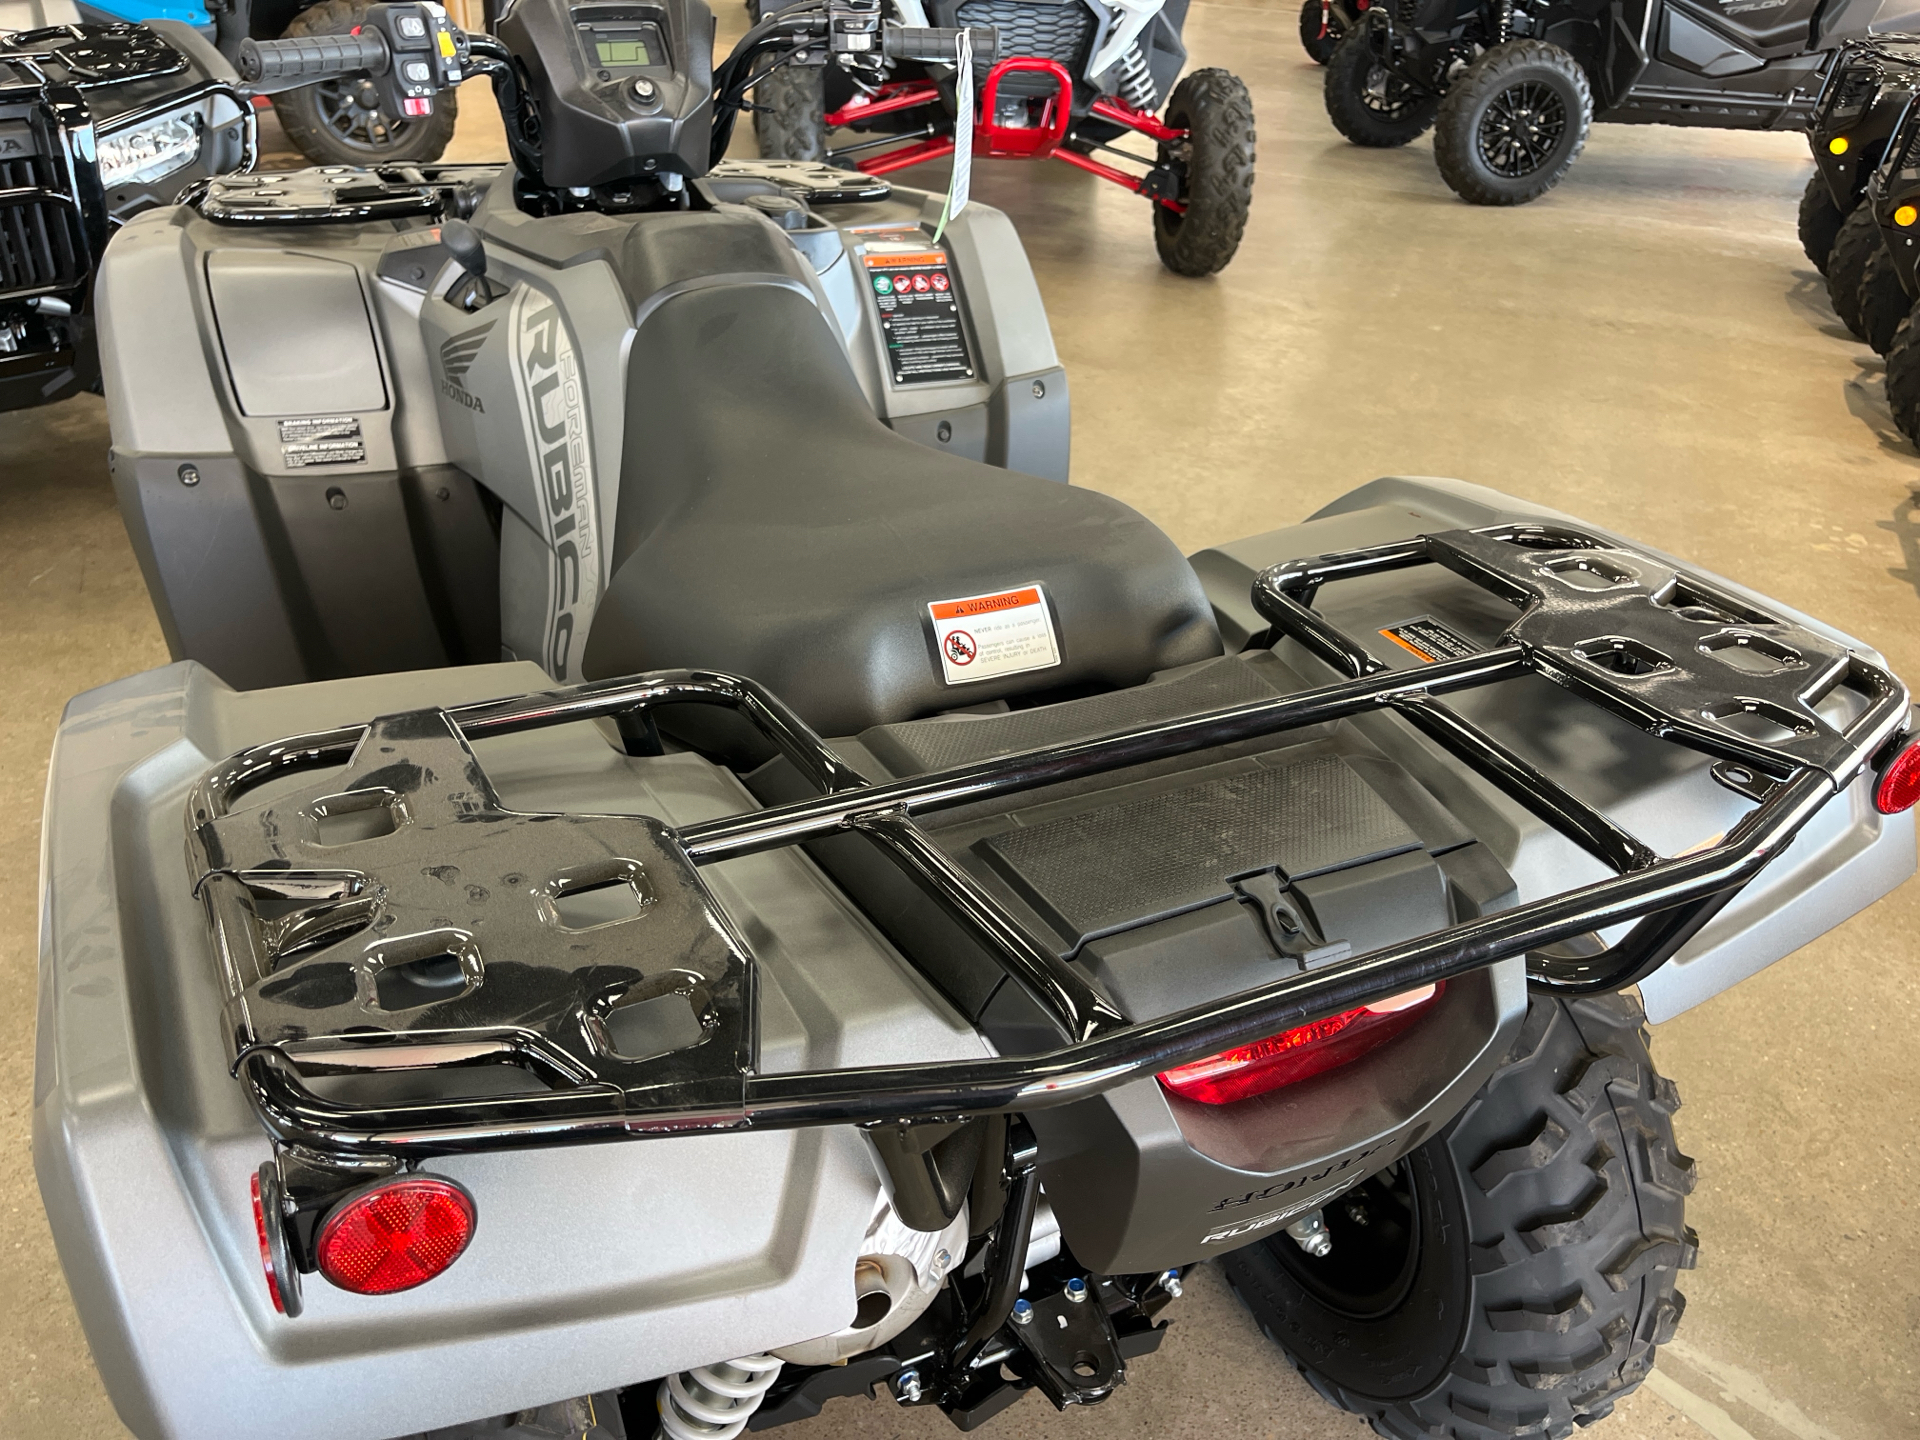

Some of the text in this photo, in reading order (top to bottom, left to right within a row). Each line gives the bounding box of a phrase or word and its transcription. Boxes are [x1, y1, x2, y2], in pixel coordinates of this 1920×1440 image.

[440, 378, 486, 414] HONDA
[559, 348, 591, 559] FOREMAN
[526, 303, 579, 682] RUBICO
[967, 595, 1019, 612] WARNING
[973, 626, 992, 634] NEVER
[980, 655, 1001, 664] SEVERE
[1003, 650, 1021, 659] INJURY
[1206, 1138, 1396, 1214] HONDA
[1200, 1178, 1356, 1245] RUBICON
